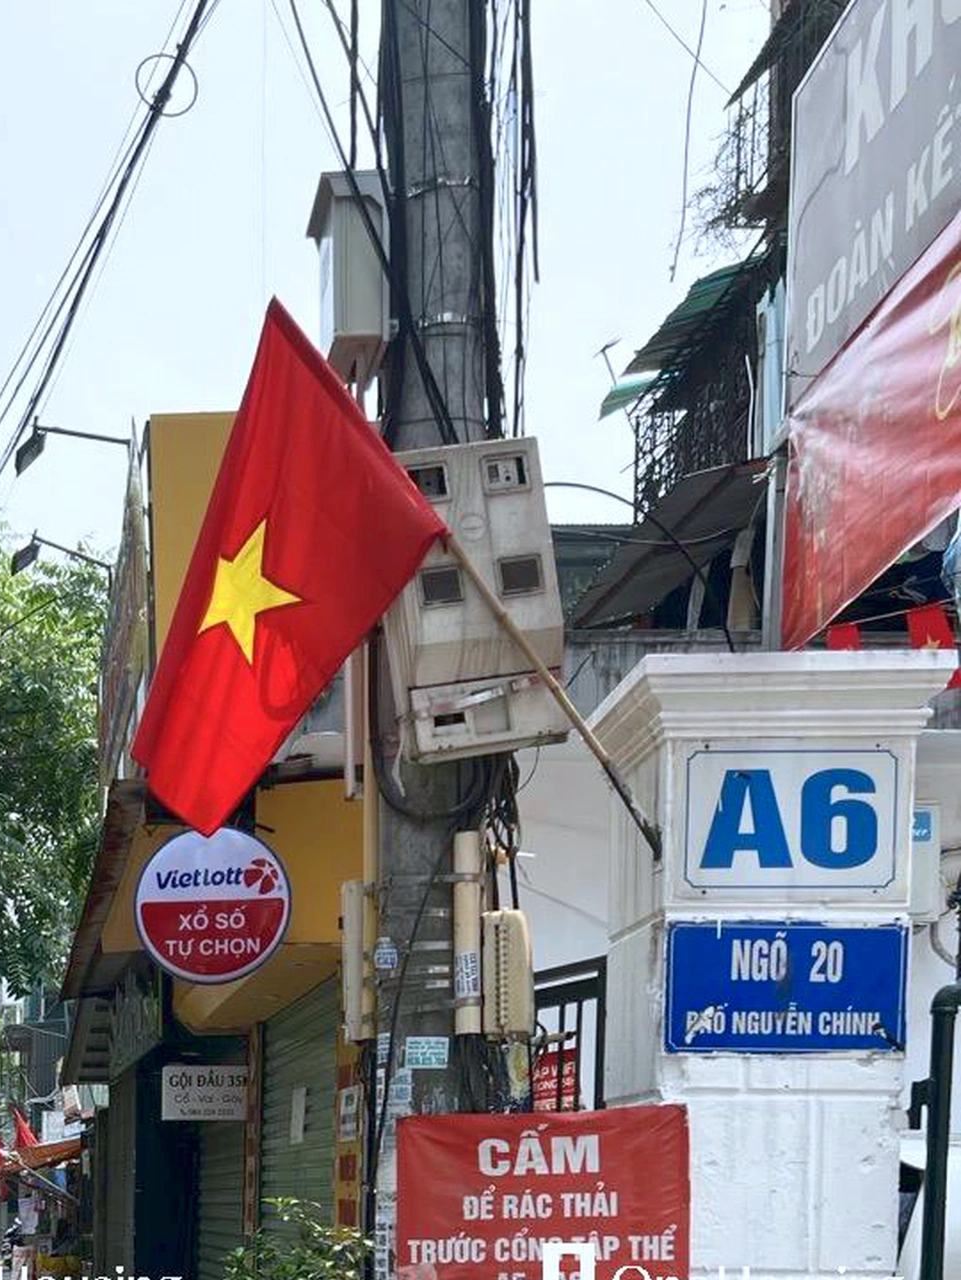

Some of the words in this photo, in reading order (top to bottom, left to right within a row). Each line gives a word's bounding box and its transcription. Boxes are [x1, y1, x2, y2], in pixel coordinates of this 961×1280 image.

[699, 768, 878, 870] A6
[156, 867, 243, 890] Vietlott
[179, 904, 209, 931] XỔ
[215, 905, 247, 929] SỐ
[165, 939, 194, 960] TỰ
[199, 938, 261, 959] CHỌN
[730, 931, 787, 981] NGÕ
[809, 940, 844, 983] 20
[731, 1002, 812, 1035] NGUYỄN
[818, 1005, 881, 1036] CHÍNH
[478, 1124, 600, 1177] CẤM
[463, 1186, 495, 1221] ĐỂ
[502, 1188, 553, 1220] RÁC
[560, 1181, 618, 1218] THẢI
[408, 1231, 486, 1264] TRƯỚC
[628, 1224, 677, 1261] THỂ
